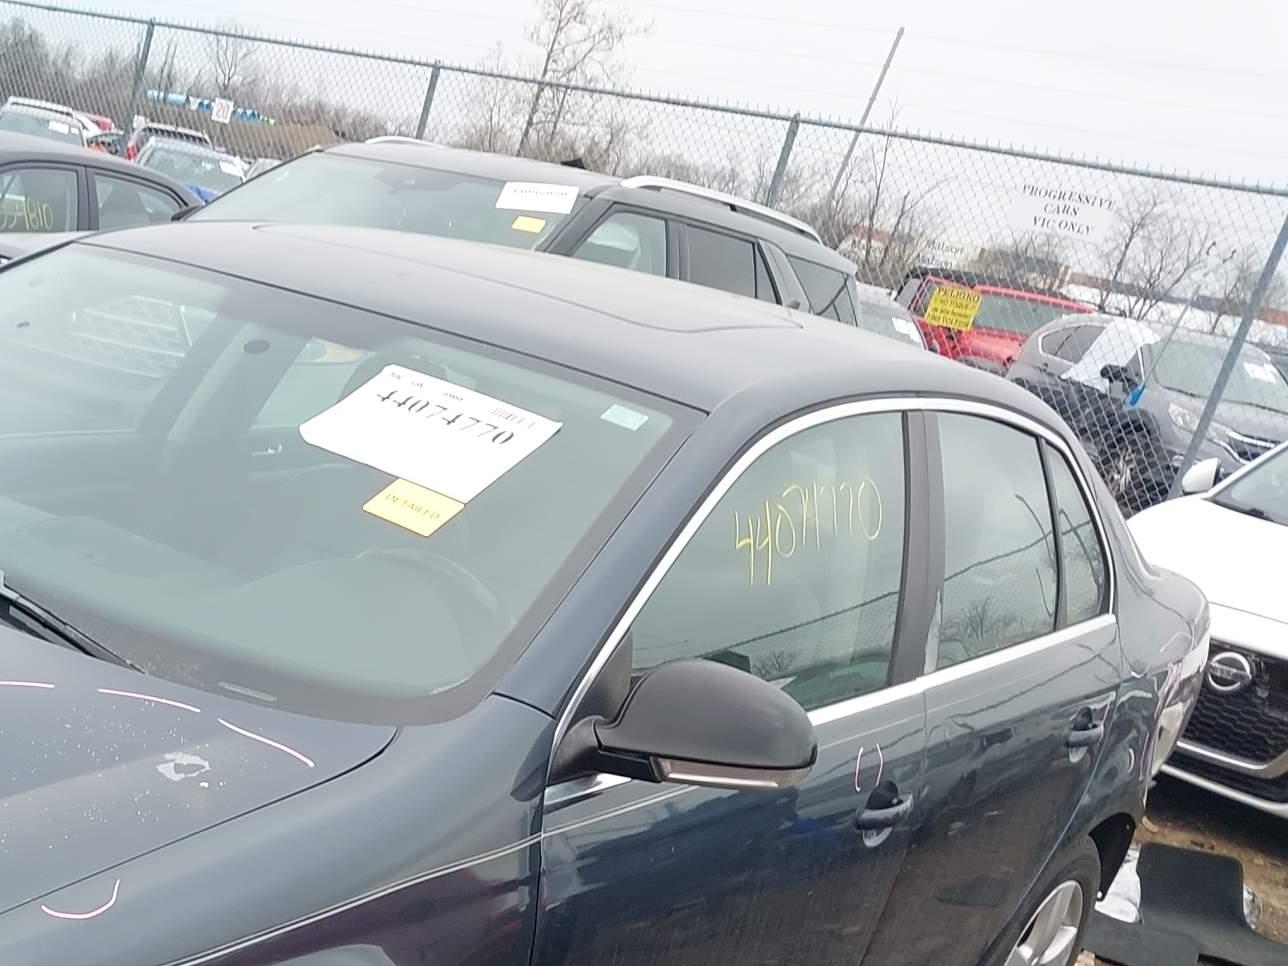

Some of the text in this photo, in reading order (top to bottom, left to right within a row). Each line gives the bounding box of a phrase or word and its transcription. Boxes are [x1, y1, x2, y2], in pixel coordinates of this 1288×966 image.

[215, 102, 230, 119] 20
[1022, 184, 1117, 212] PROGRESSIVE
[1043, 203, 1080, 217] CARS
[1058, 219, 1095, 236] ONLY
[376, 390, 515, 445] 44074770
